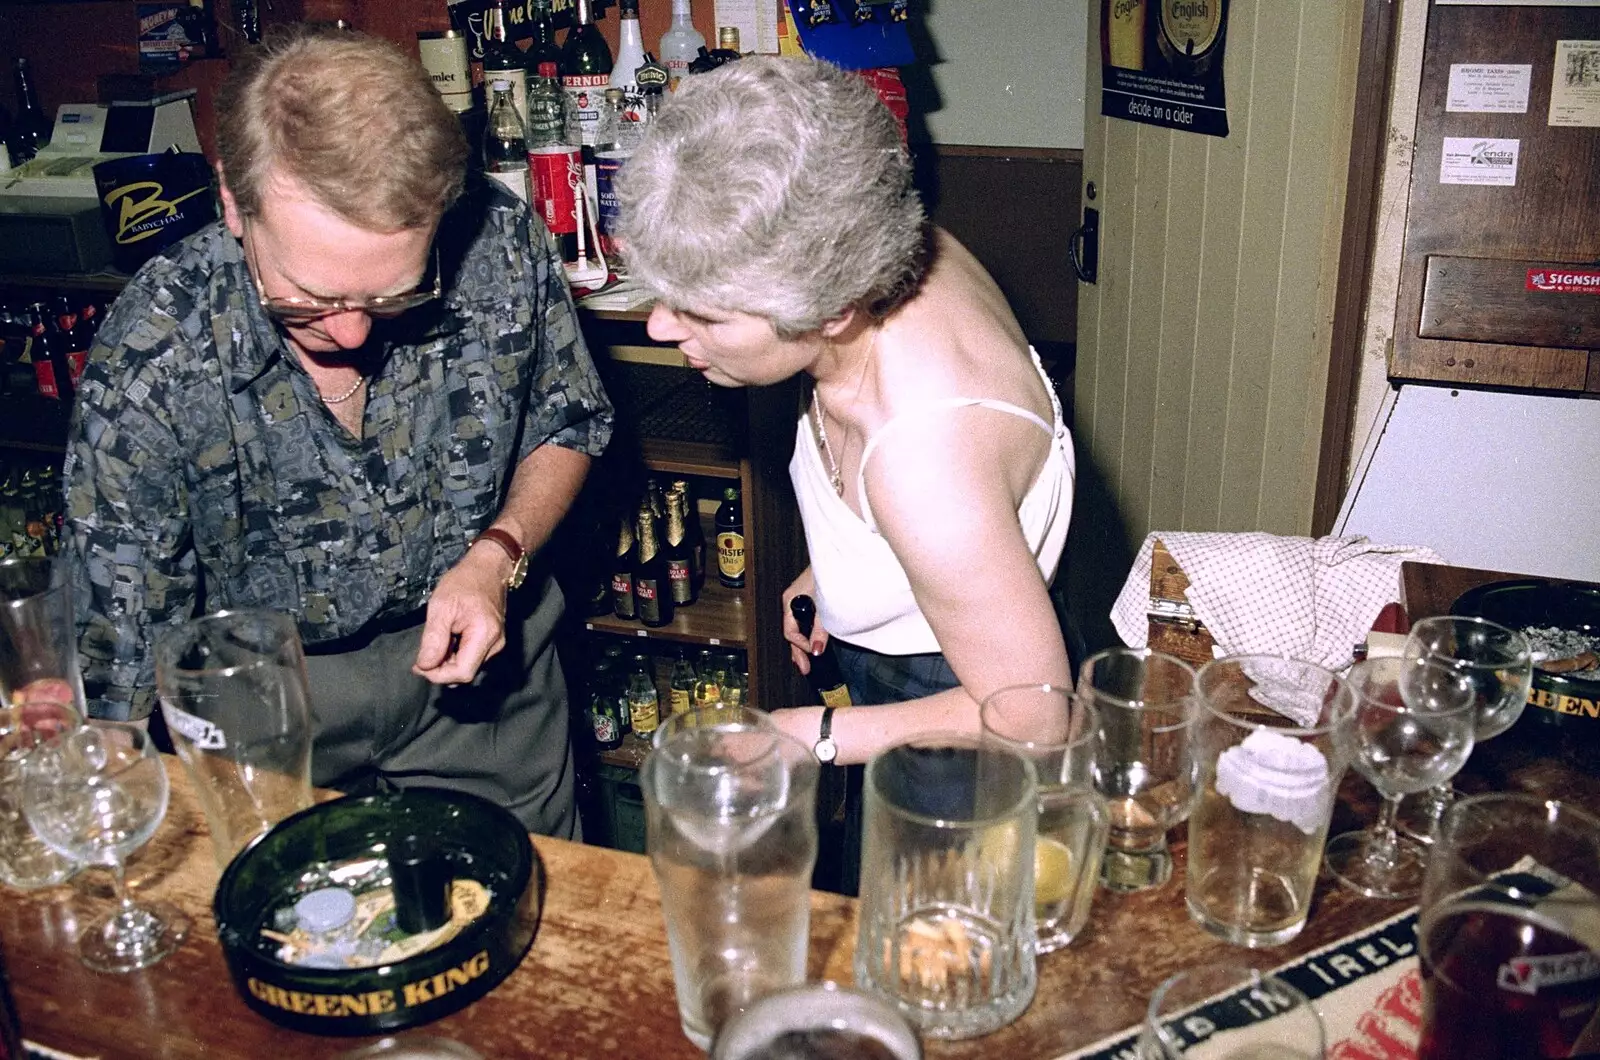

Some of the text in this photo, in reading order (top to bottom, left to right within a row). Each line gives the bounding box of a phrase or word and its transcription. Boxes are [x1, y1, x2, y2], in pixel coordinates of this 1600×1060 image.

[1172, 1, 1208, 20] English
[1129, 97, 1193, 124] decide on a cider
[131, 212, 185, 233] BABYCHAM
[1307, 925, 1420, 985] IREL
[403, 949, 490, 1008] KING
[248, 976, 396, 1018] GREENE
